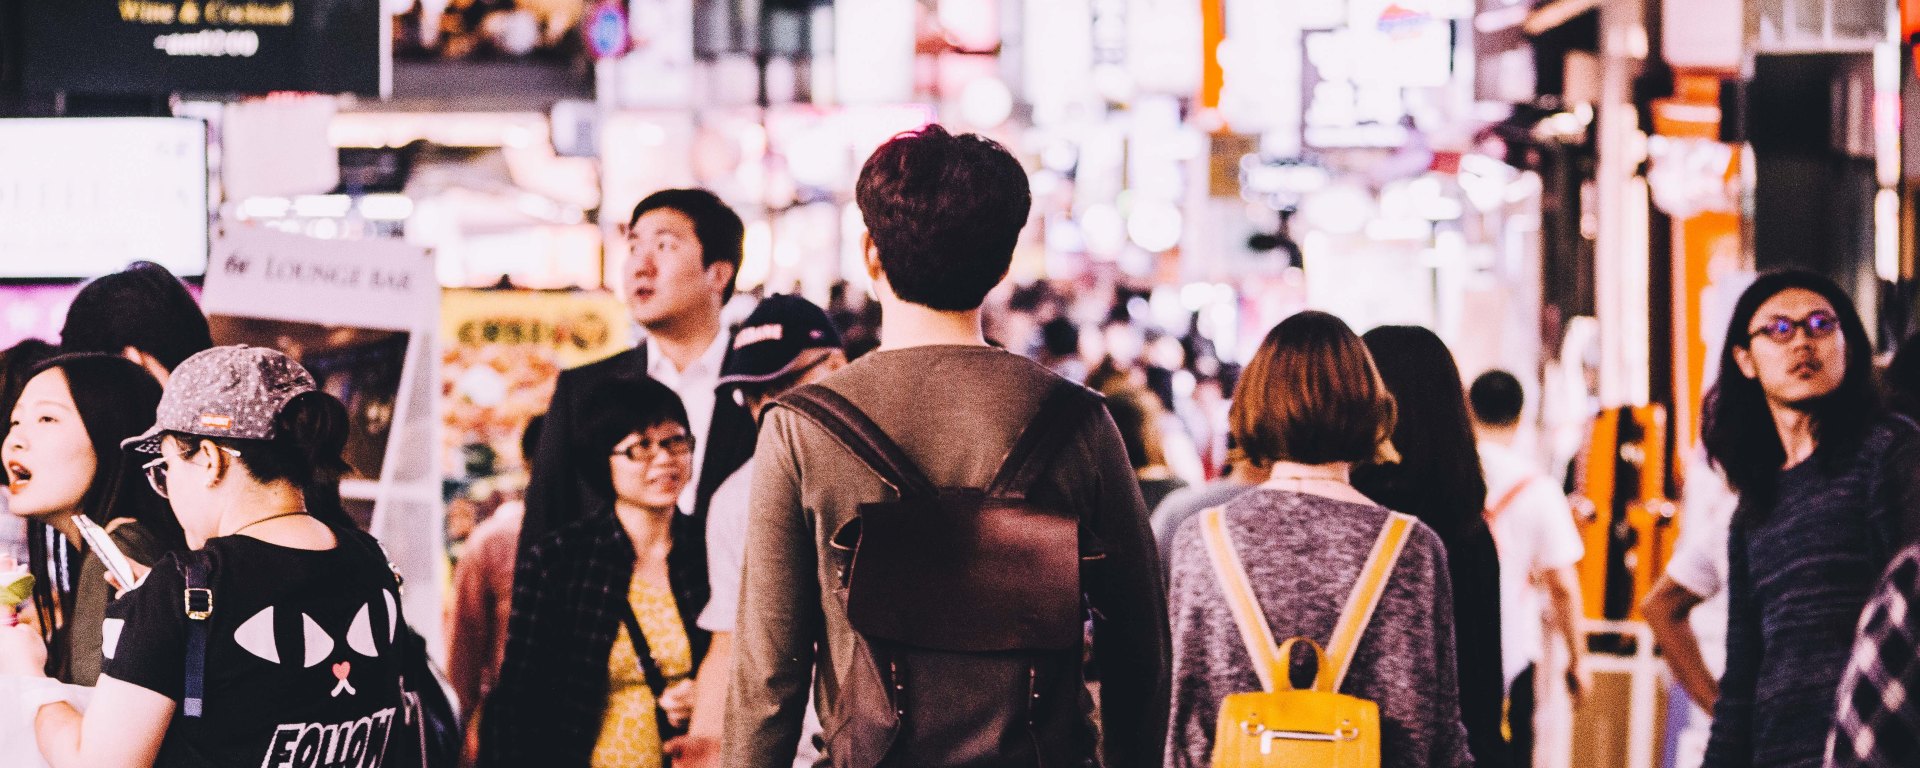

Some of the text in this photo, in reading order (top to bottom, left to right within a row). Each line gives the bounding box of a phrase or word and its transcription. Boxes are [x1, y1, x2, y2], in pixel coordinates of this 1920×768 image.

[118, 0, 176, 24] Wine
[178, 0, 200, 24] &
[260, 707, 396, 768] FOLLOW
